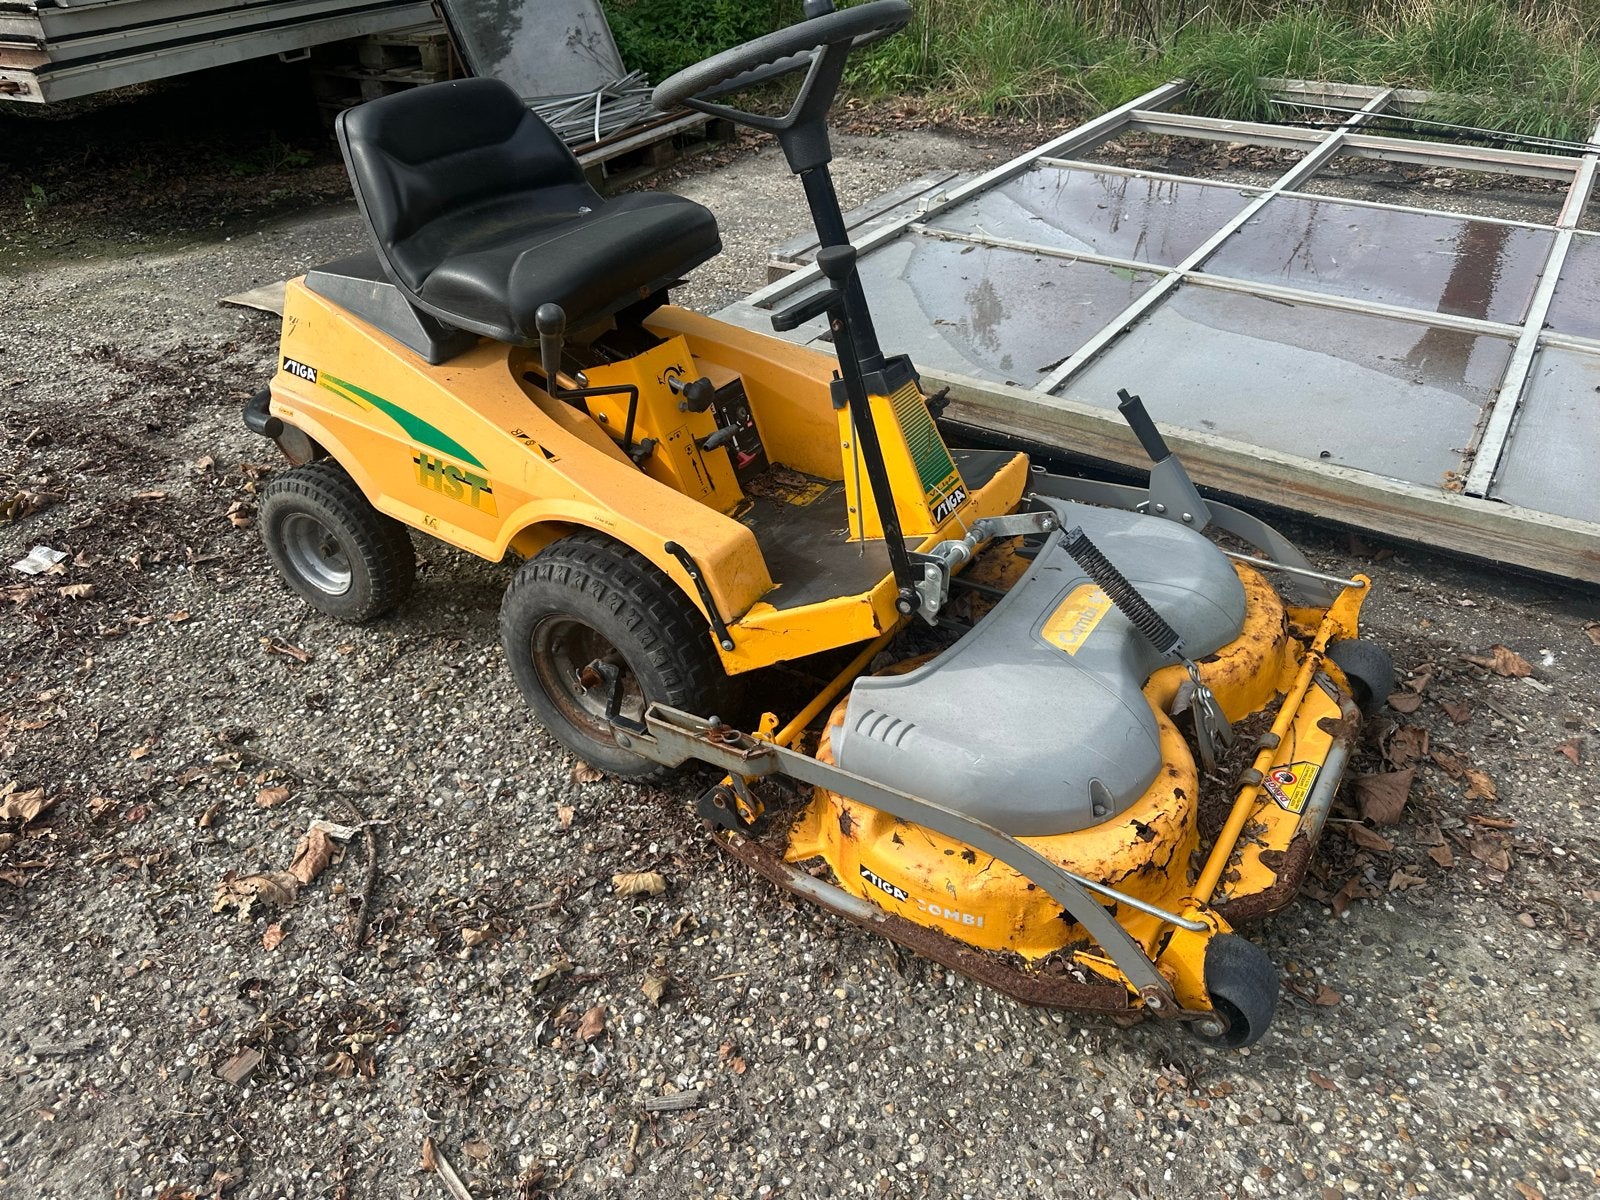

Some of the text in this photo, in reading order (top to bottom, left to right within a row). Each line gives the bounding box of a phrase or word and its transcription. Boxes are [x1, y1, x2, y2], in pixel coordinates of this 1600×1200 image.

[283, 359, 317, 382] STIGA
[420, 453, 488, 508] HST
[936, 486, 966, 522] STIGA
[860, 869, 908, 902] STIGA
